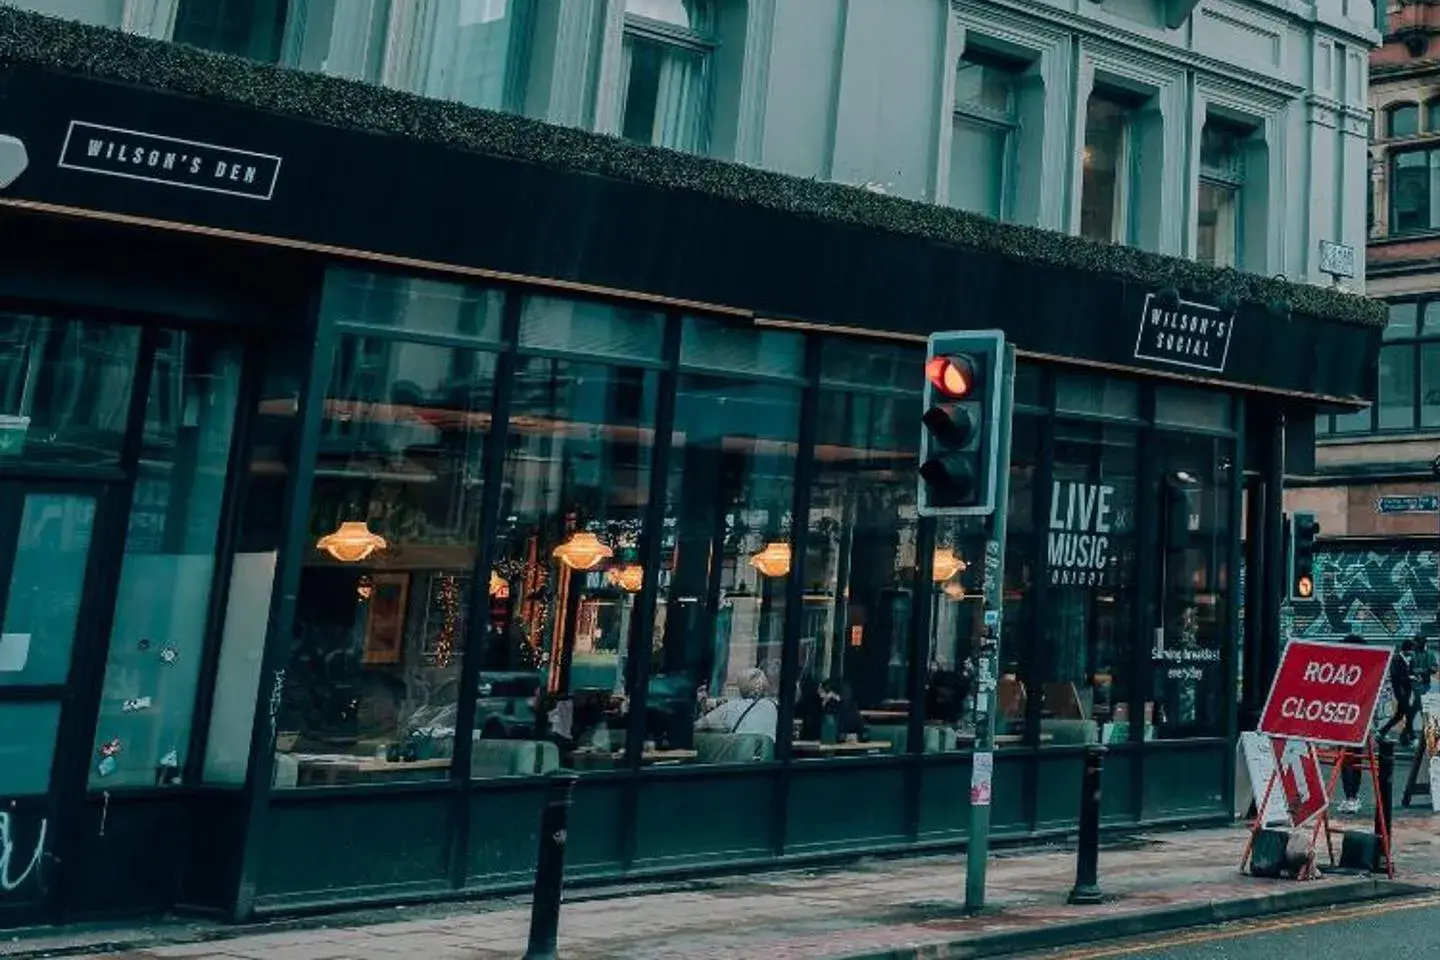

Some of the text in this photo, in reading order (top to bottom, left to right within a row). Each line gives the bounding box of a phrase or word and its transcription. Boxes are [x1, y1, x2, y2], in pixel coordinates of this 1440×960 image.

[87, 138, 257, 184] WILSON'S DEN
[1151, 308, 1226, 338] WILSON'S
[1156, 331, 1209, 357] SOCIAL
[1049, 481, 1115, 533] LIVE
[1047, 531, 1109, 569] MUSIC
[1303, 661, 1362, 686] ROAD
[1281, 696, 1361, 725] CLOSED
